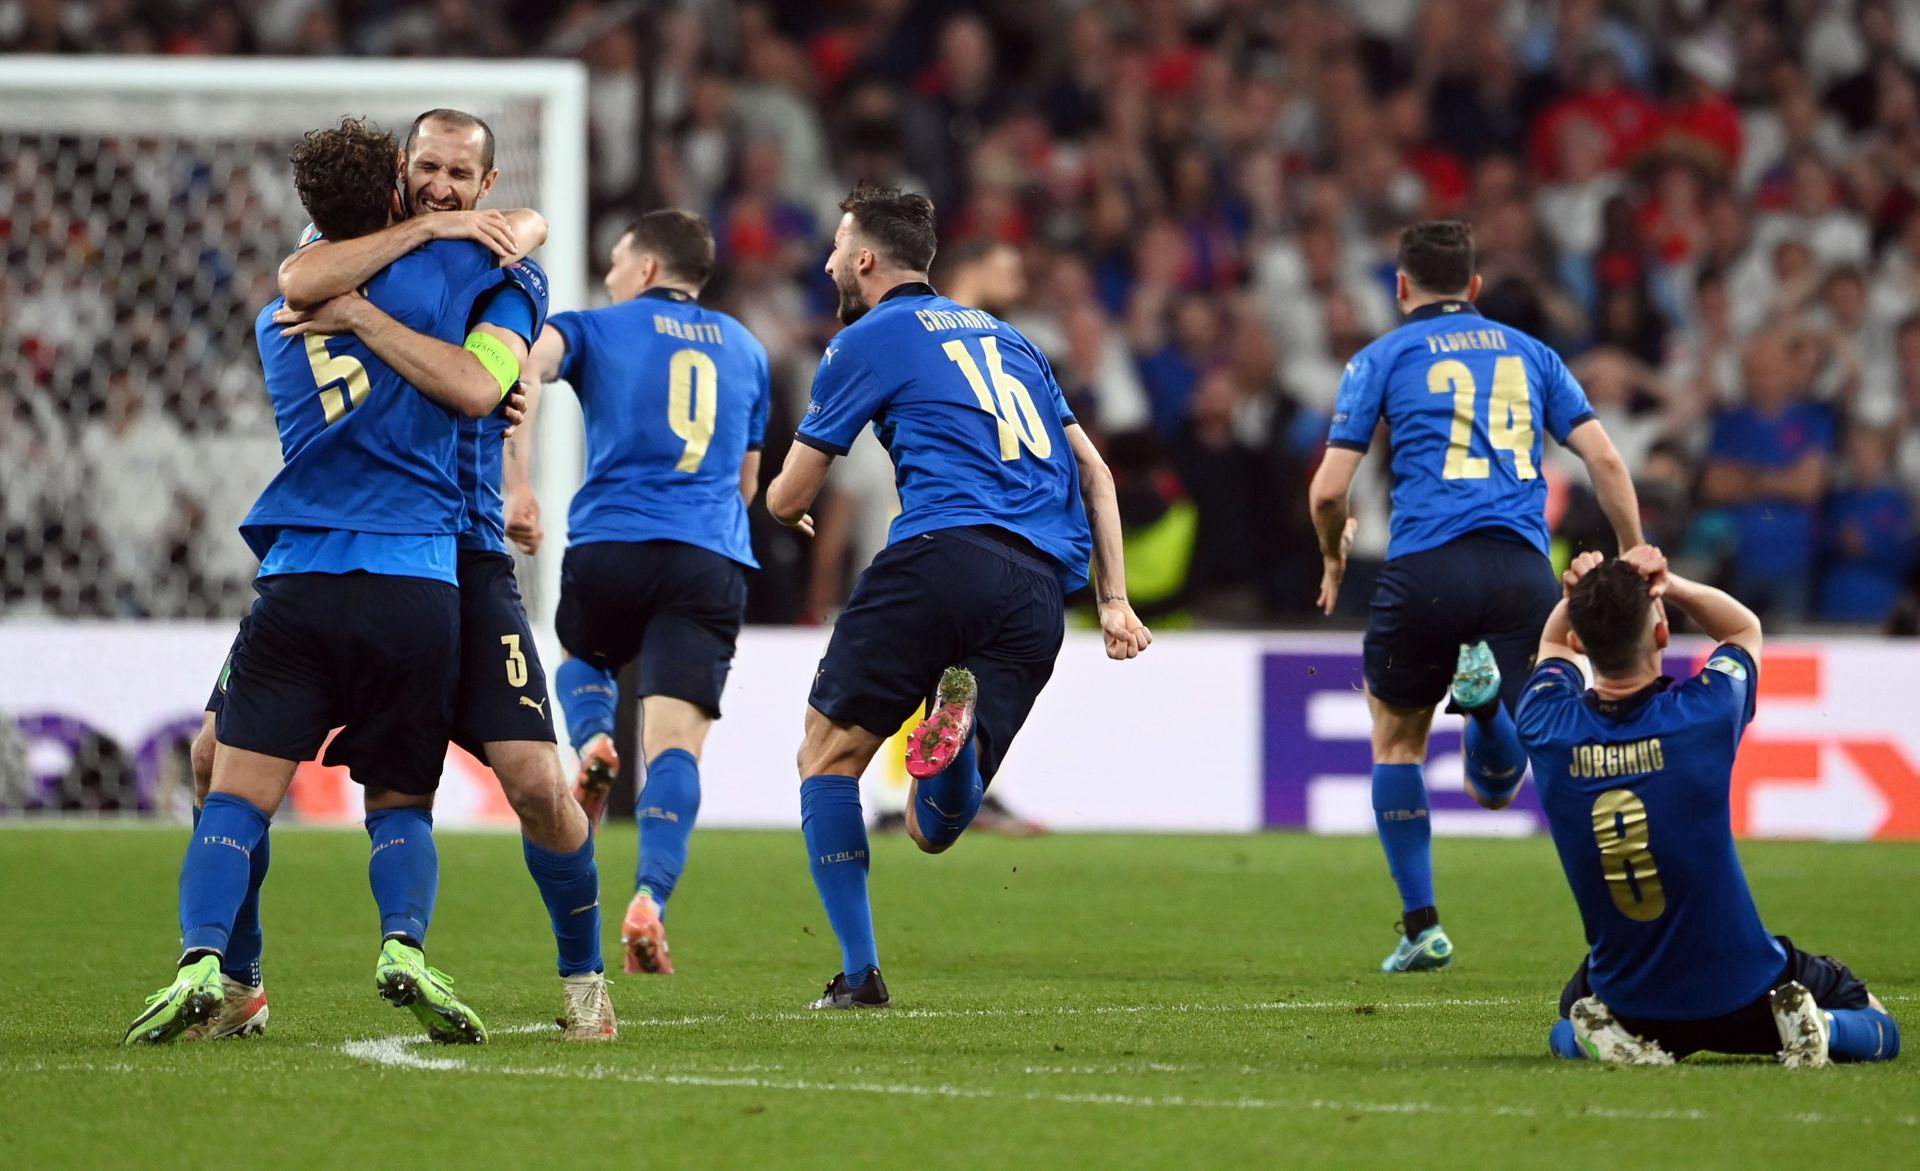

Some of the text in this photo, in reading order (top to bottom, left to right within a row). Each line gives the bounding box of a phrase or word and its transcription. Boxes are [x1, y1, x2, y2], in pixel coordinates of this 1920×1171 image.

[653, 314, 723, 345] BELOTTI
[915, 308, 999, 333] CRISTANTE
[1427, 328, 1508, 354] FLORENZI
[470, 343, 506, 366] RESPECT
[303, 332, 371, 426] 5
[941, 336, 1053, 462] 16
[667, 348, 718, 473] 9
[1427, 356, 1538, 481] 24
[500, 634, 529, 688] 3
[1569, 738, 1665, 779] JORGINHO
[372, 838, 405, 854] ALIA
[821, 850, 865, 865] ITALIA
[1590, 790, 1667, 922] 8
